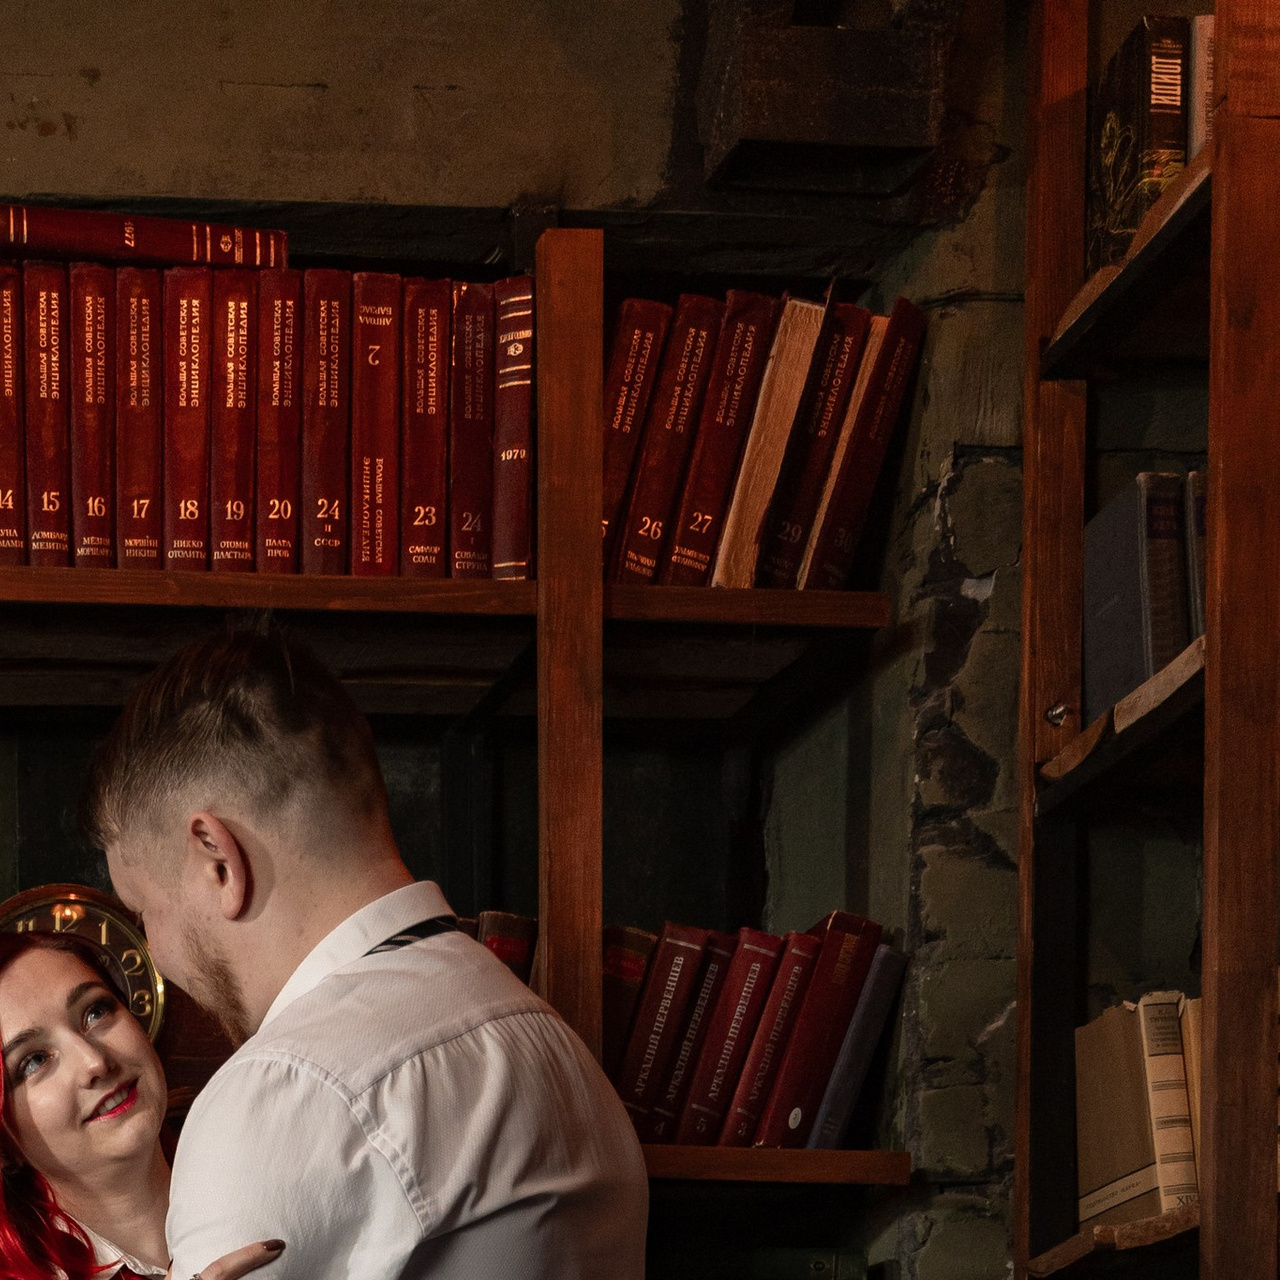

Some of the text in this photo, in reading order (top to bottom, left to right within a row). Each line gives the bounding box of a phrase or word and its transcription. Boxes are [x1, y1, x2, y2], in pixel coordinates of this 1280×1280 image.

[1151, 55, 1181, 106] ИДИОТ
[3, 290, 12, 397] ЭНЦИКЛОПЕДИЯ
[39, 291, 48, 398] БОЛЬШАЯ СОВЕТСКАЯ
[51, 292, 59, 399] ЭНЦИКЛОПЕДИЯ
[84, 296, 93, 404] БОЛЬШАЯ СОВЕТСКАЯ
[97, 296, 106, 404] ЭНЦИКЛОПЕДИЯ
[129, 298, 138, 406] БОЛЬШАЯ СОВЕТСКАЯ
[141, 298, 150, 407] ЭНЦИКЛОПЕДИЯ
[179, 299, 188, 356] СОВЕТСКАЯ
[191, 299, 200, 408] ЭНЦИКЛОПЕДИЯ
[226, 301, 236, 408] БОЛЬШАЯ СОВЕТСКАЯ
[238, 301, 248, 408] ЭНЦИКЛОПЕДИЯ
[272, 299, 281, 406] БОЛЬШАЯ СОВЕТСКАЯ
[284, 300, 294, 408] ЭНЦИКЛОПЕДИЯ
[319, 299, 328, 406] БОЛЬШАЯ СОВЕТСКАЯ
[330, 300, 339, 407] ЭНЦИКЛОПЕДИЯ
[368, 345, 380, 365] 2
[428, 308, 438, 415] ЭНЦИКЛОПЕДИЯ
[416, 369, 424, 414] БОЛЬШАЯ
[41, 491, 60, 511] 15
[86, 496, 106, 516] 16
[132, 498, 150, 518] 17
[179, 499, 199, 519] 18
[225, 499, 244, 520] 19
[268, 498, 292, 519] 20
[316, 498, 340, 520] 24
[362, 456, 371, 562] ЭНЦИКЛОПЕДИЯ
[376, 458, 384, 564] БОЛЬШАЯ СОВЕТСКАЯ
[413, 506, 437, 526] 23
[461, 512, 482, 531] 24
[638, 517, 663, 539] 26
[689, 512, 712, 534] 27
[173, 539, 203, 549] НИККО
[219, 539, 249, 549] ОТОМИ
[265, 538, 292, 548] ПЛАТА
[267, 548, 290, 558] ПРОБ
[314, 538, 341, 548] СССР
[778, 521, 802, 543] 29
[654, 956, 684, 1034] ПЕРВЕНЦЕВ
[729, 962, 760, 1041] ПЕРВЕНЦЕВ
